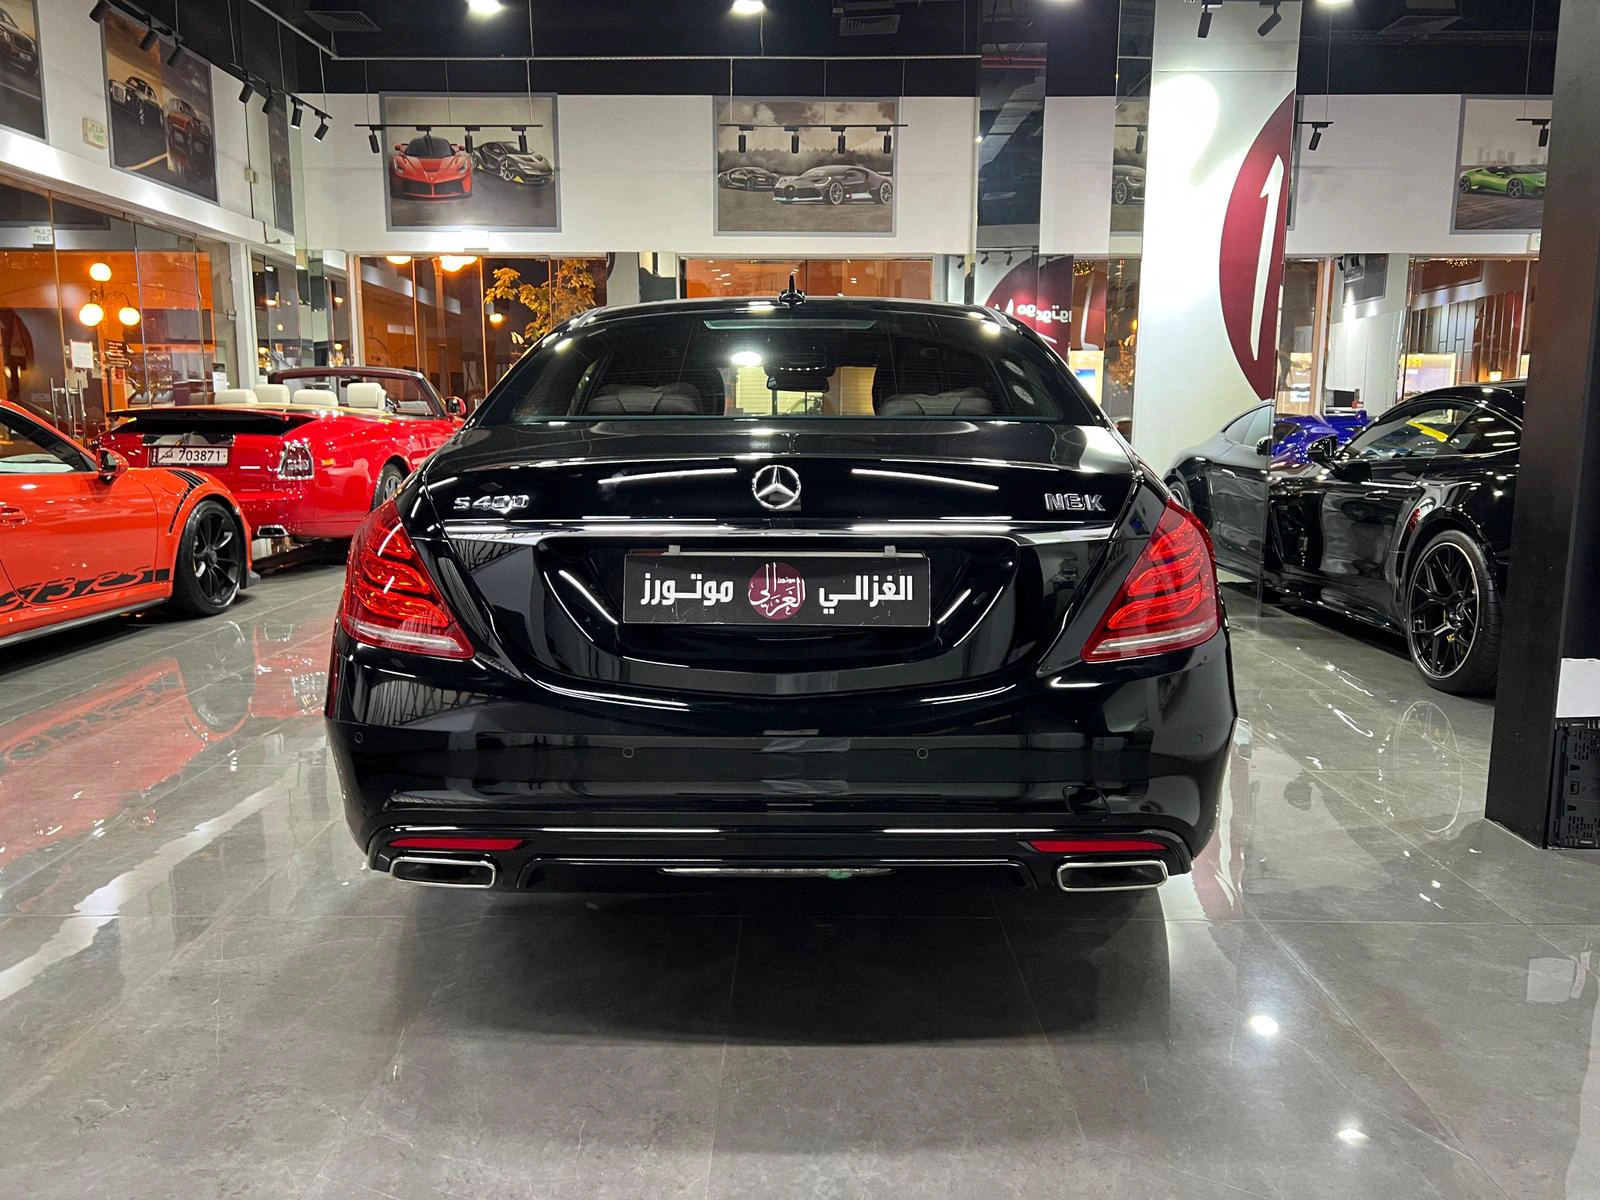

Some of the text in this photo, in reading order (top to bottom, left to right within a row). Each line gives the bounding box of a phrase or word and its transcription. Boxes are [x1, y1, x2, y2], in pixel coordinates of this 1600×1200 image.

[178, 449, 221, 462] 703871
[453, 496, 471, 510] S
[1044, 493, 1106, 512] NBK
[640, 572, 913, 615] الغزالي موتورز
